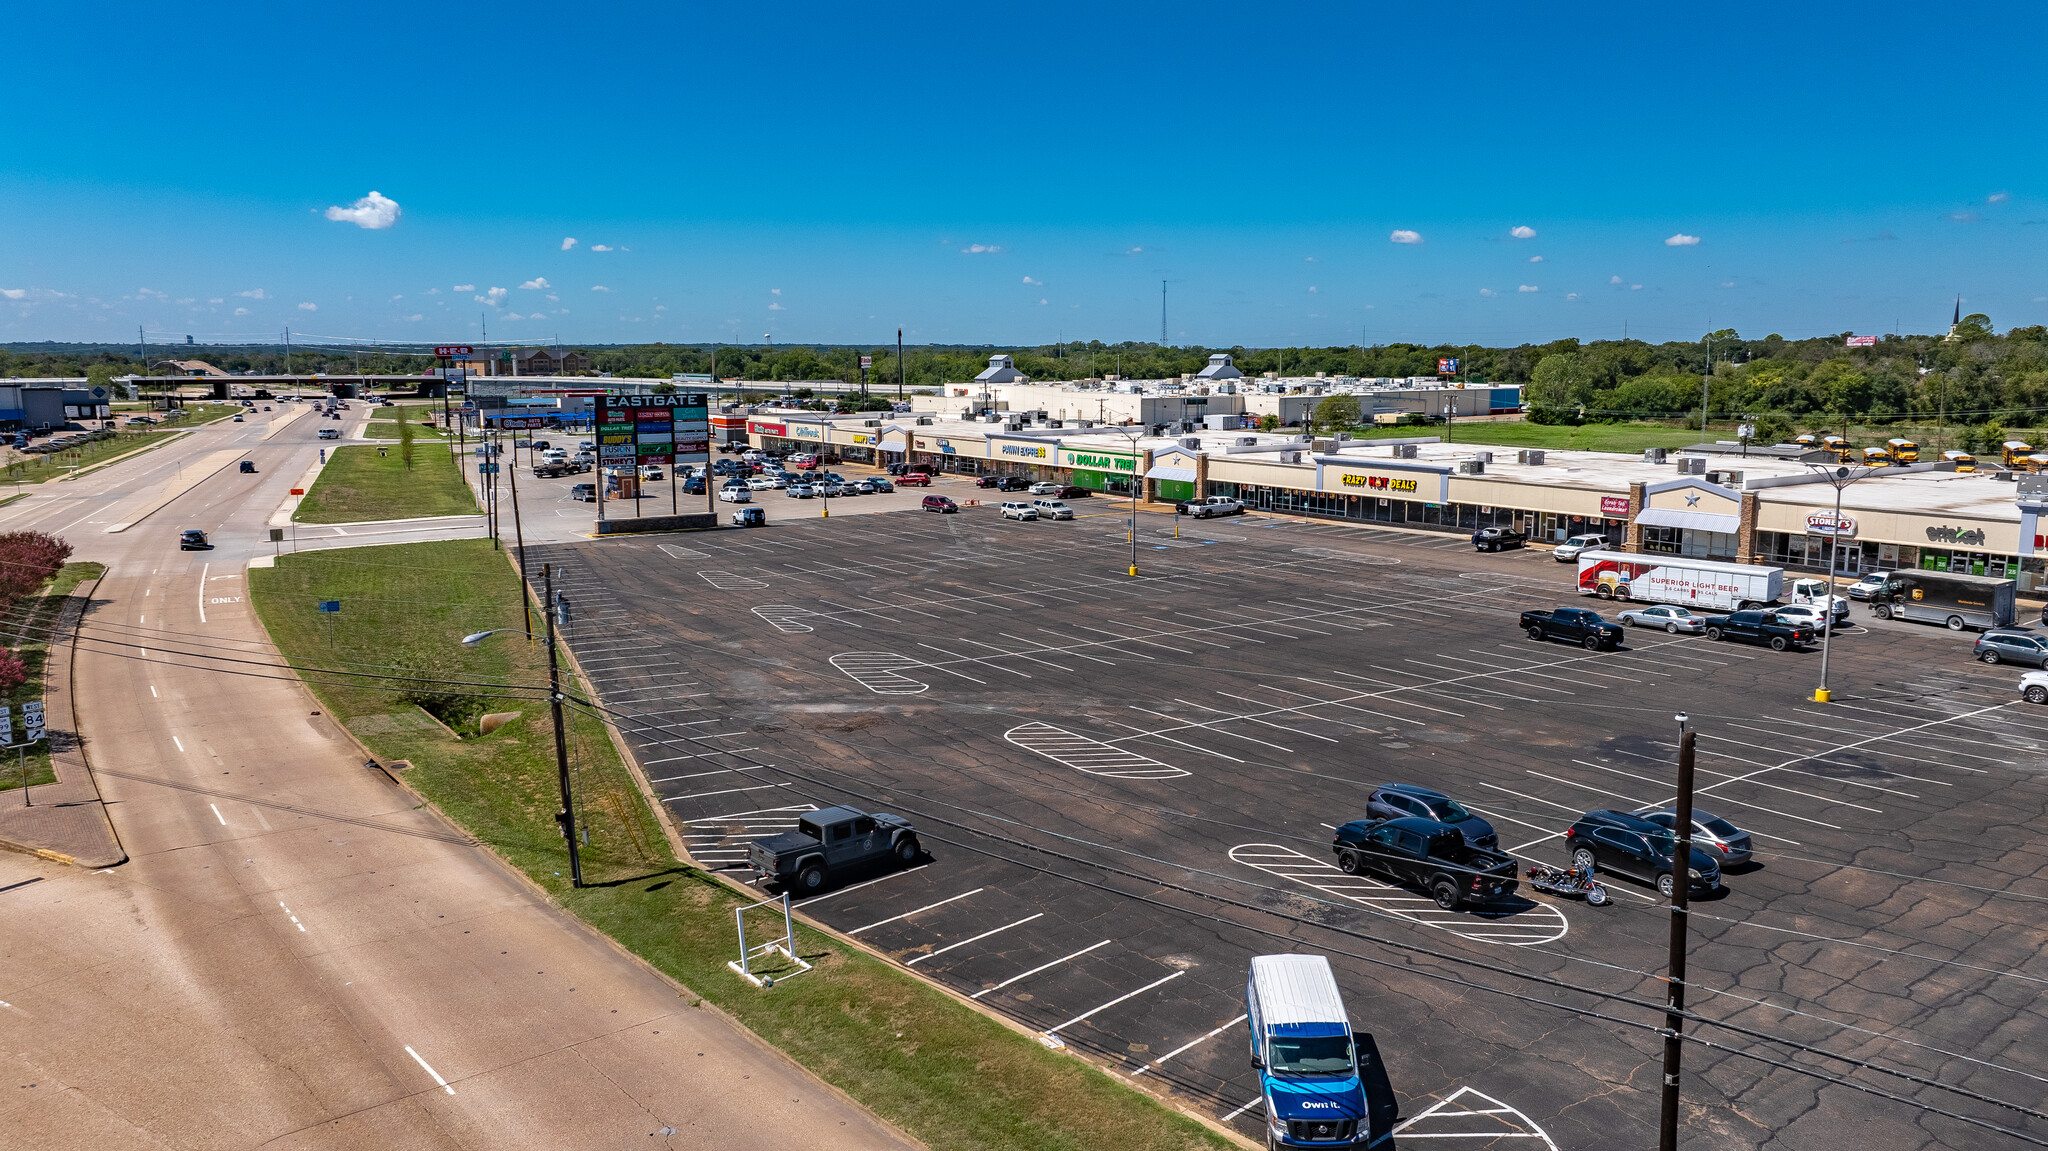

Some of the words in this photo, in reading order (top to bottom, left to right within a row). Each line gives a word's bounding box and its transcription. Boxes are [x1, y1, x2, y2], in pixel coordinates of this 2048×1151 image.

[606, 395, 698, 407] EASTGATE
[603, 435, 632, 444] BUDDY'S
[641, 445, 668, 453] cricket
[1002, 444, 1020, 456] PAWN
[602, 457, 635, 466] STONEY'S
[1076, 454, 1110, 469] DOLLAR
[1341, 474, 1367, 486] CRAZY
[1368, 476, 1389, 489] HOT
[1390, 479, 1417, 491] DEALS
[1809, 517, 1850, 528] STONEY'S
[1925, 525, 1985, 546] cricket
[1651, 578, 1690, 587] SUPERIOR
[1692, 582, 1715, 590] LIGHT
[1718, 585, 1739, 593] BEER
[211, 596, 241, 604] ONLY
[26, 714, 43, 725] 84
[1302, 1101, 1329, 1109] Own
[1330, 1101, 1340, 1109] it.
